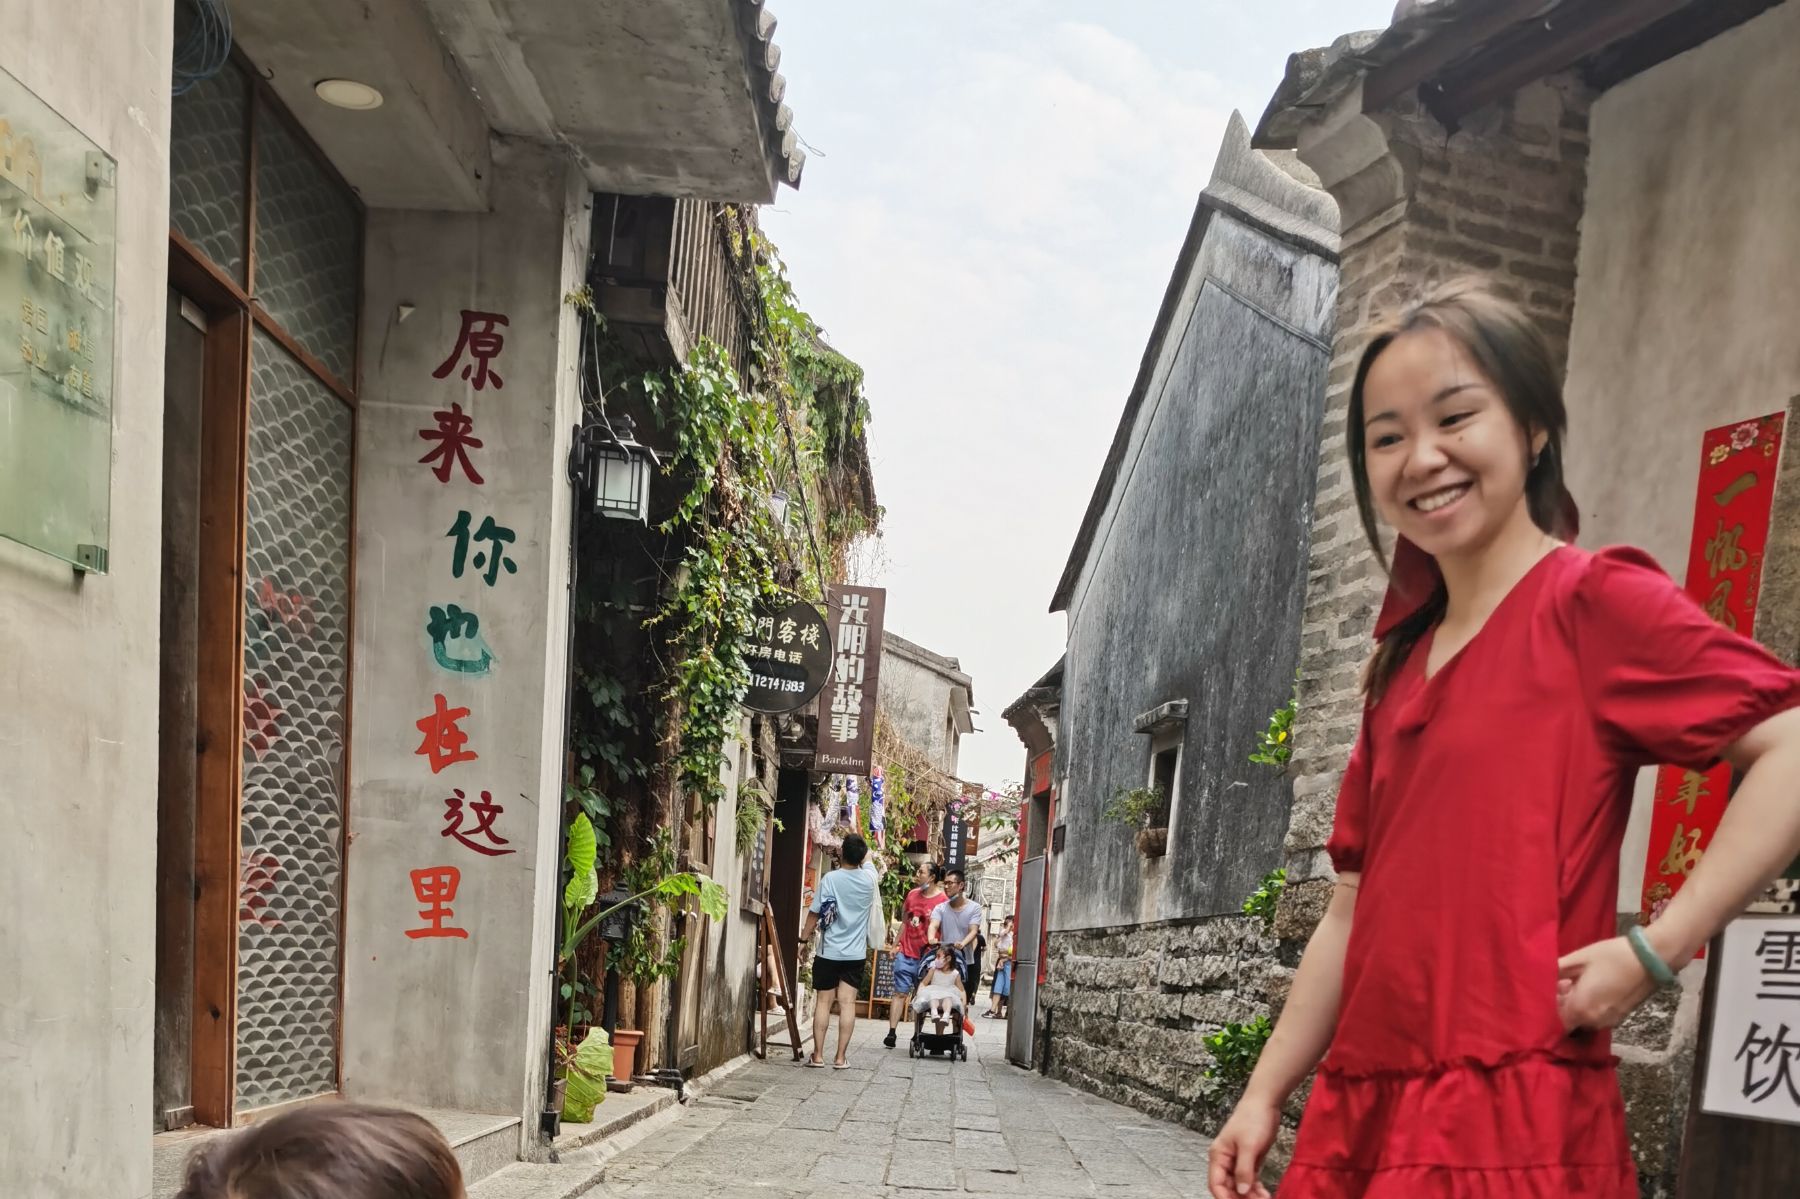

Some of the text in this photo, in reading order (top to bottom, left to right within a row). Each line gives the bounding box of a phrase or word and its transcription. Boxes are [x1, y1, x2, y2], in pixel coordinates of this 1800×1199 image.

[404, 309, 518, 941] 原来你也在这里
[829, 593, 870, 743] 光阴的故事
[821, 753, 864, 767] Bar&Inn
